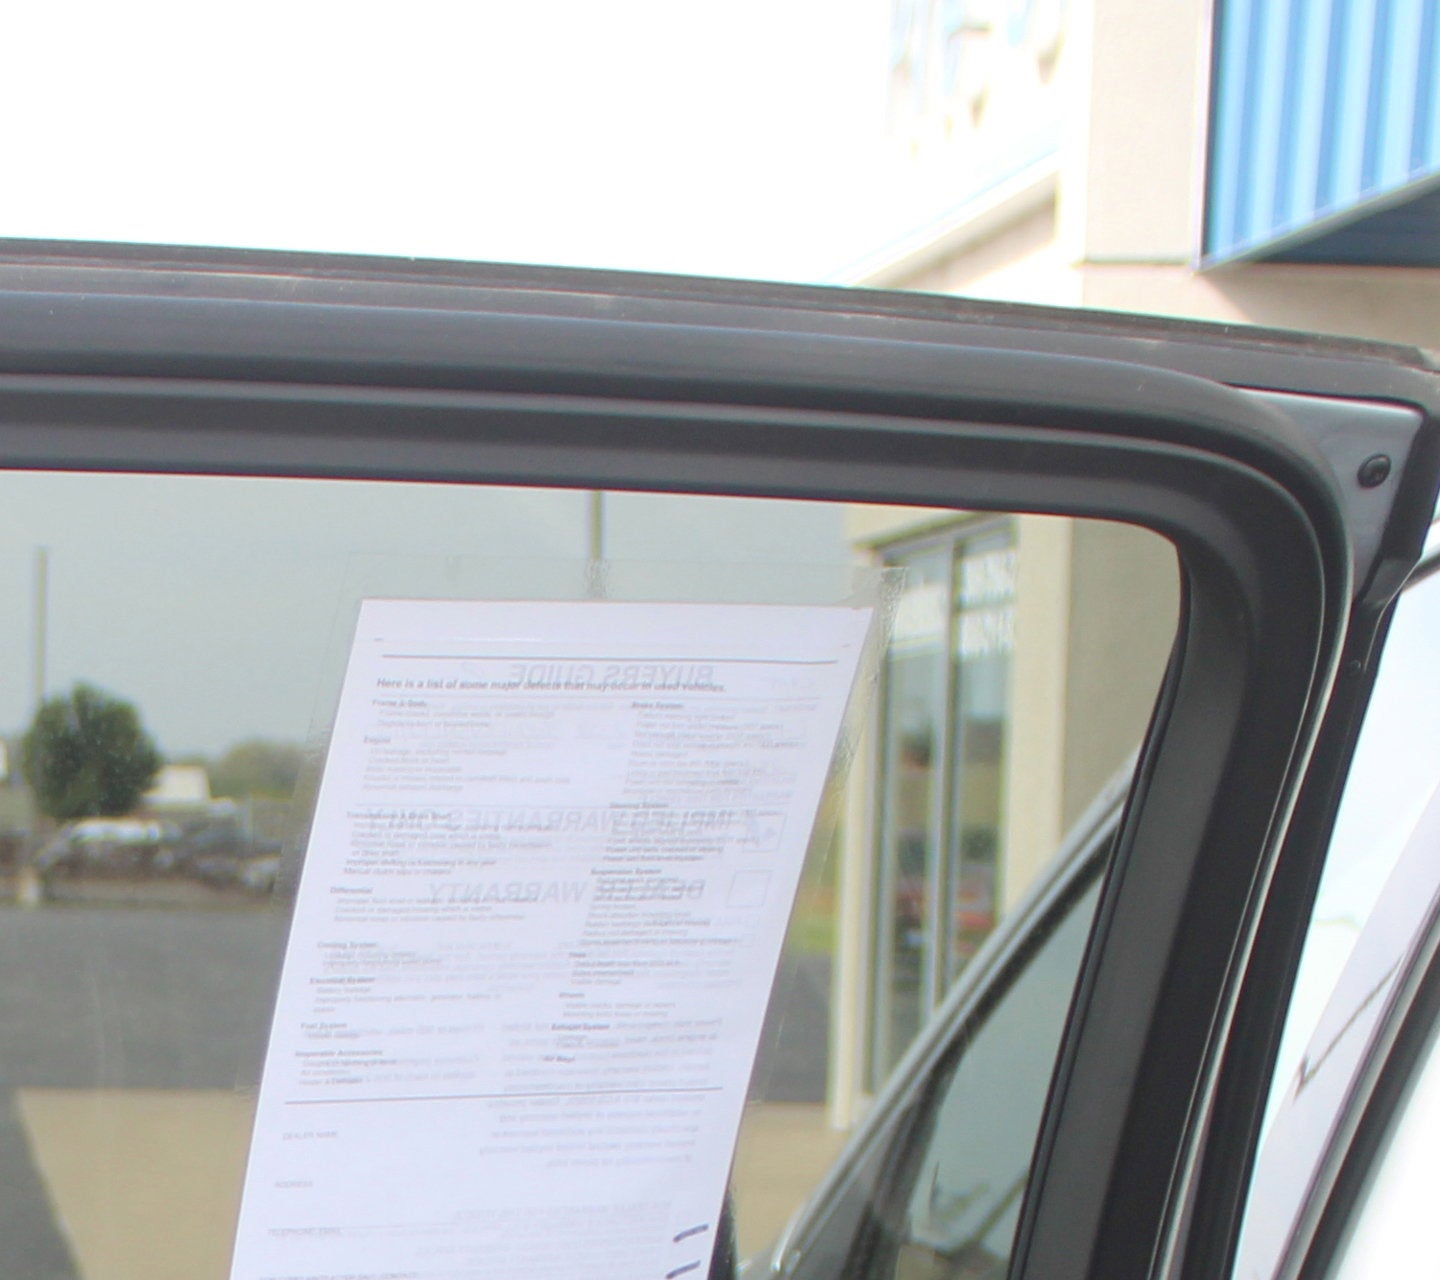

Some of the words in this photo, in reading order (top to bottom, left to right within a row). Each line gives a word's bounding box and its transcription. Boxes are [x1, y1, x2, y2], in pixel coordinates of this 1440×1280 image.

[376, 678, 403, 689] Here
[404, 678, 414, 689] is
[417, 681, 424, 689] a
[426, 679, 444, 690] list
[446, 679, 459, 690] of
[459, 681, 489, 690] some
[490, 680, 521, 692] major
[522, 679, 562, 691] defects
[563, 680, 585, 691] that
[586, 682, 609, 693] may
[641, 681, 653, 691] in
[654, 681, 680, 692] used
